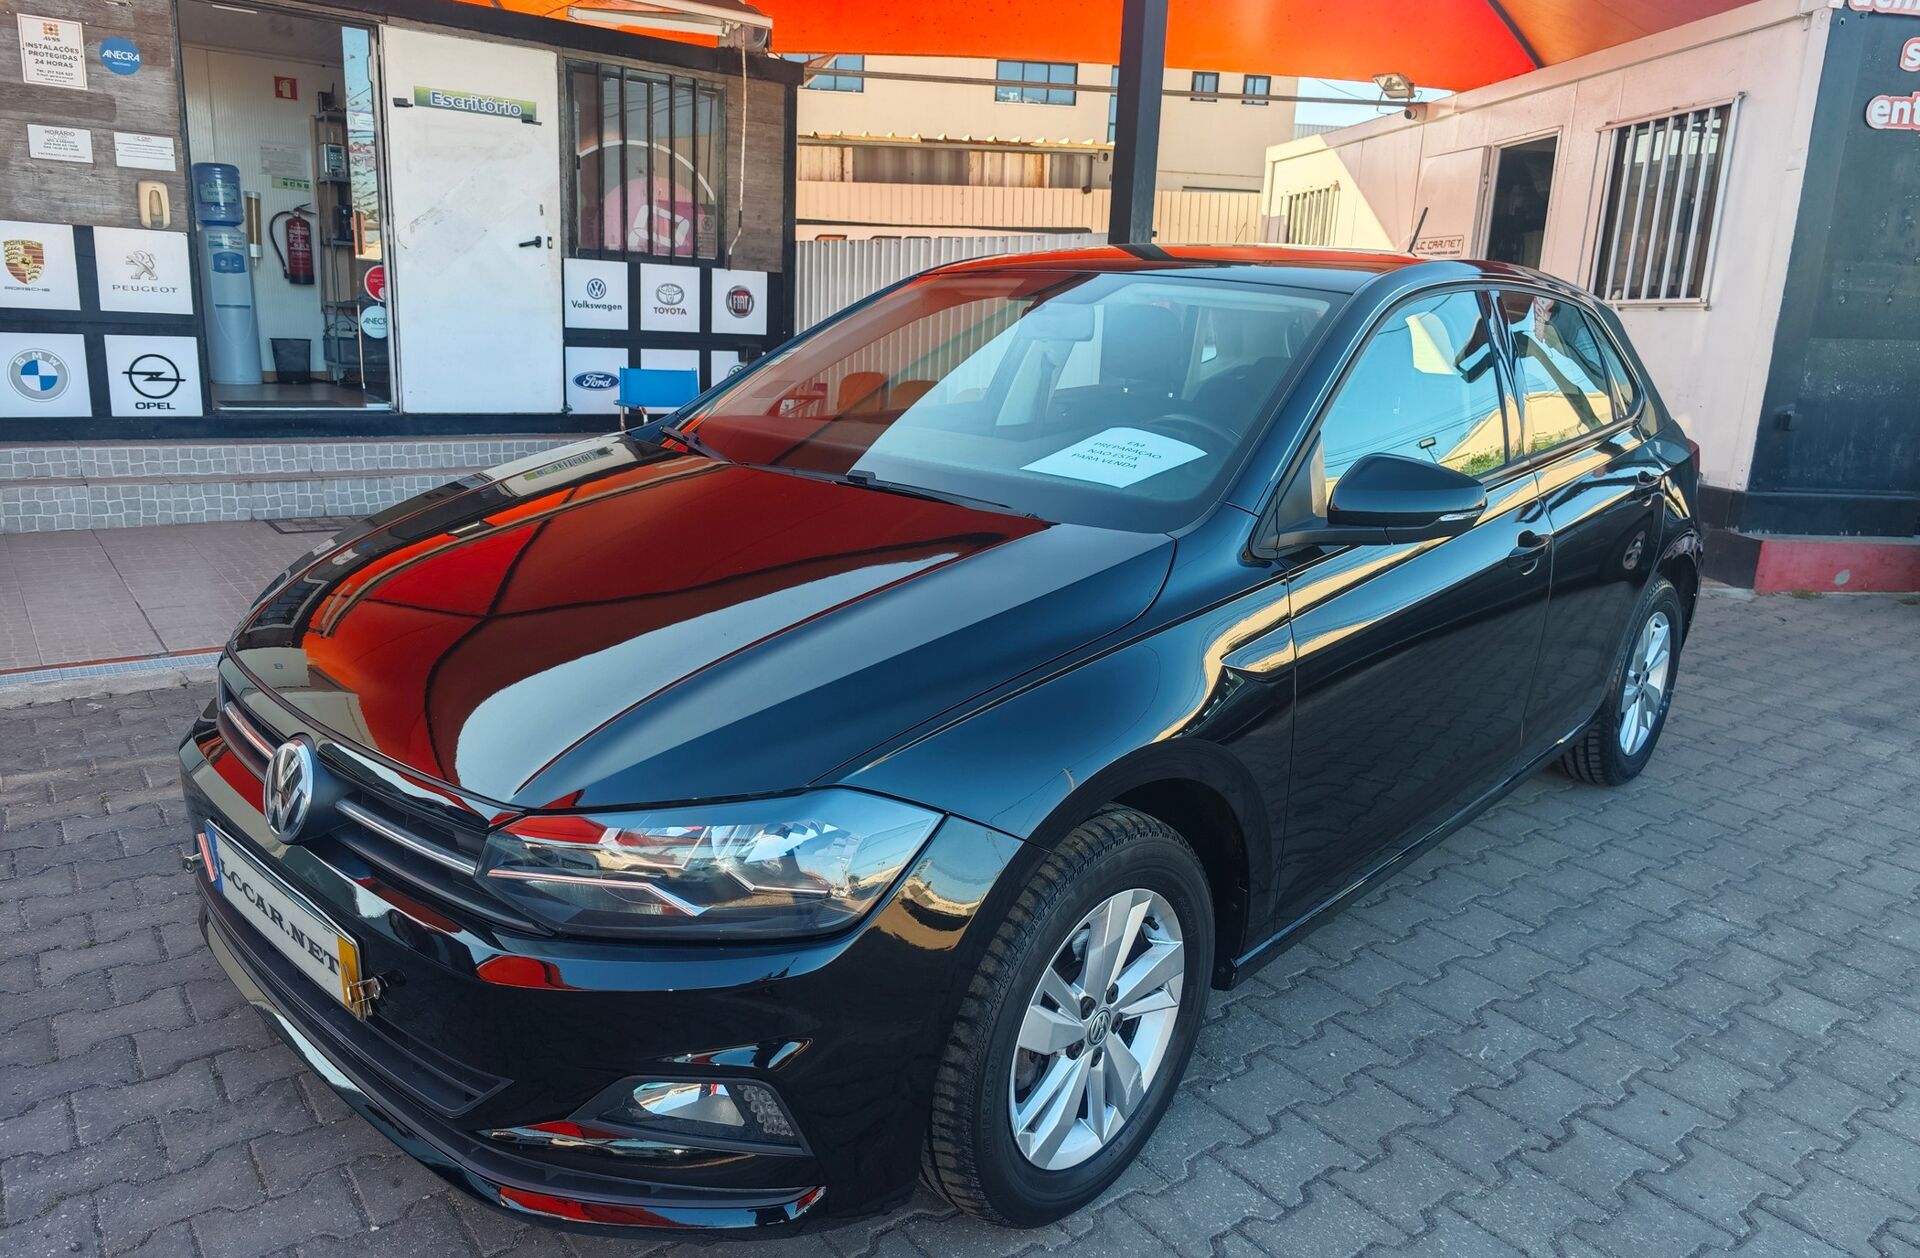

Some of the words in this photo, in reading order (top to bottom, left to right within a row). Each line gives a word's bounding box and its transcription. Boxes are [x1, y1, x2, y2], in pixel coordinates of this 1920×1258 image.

[28, 50, 78, 61] PROTEGIDAS
[102, 49, 140, 62] ANECRA
[46, 60, 74, 68] HORAS
[431, 91, 522, 116] Escritório
[112, 284, 178, 293] PEUGEOT
[571, 300, 622, 312] Volkswagen
[733, 294, 749, 310] FIAT
[653, 306, 687, 316] TOYOTA
[15, 351, 61, 367] BMW
[582, 373, 612, 388] Ford
[135, 402, 176, 410] OPEL
[1071, 453, 1099, 462] PARA
[1102, 458, 1137, 469] VENDA
[219, 858, 339, 976] LCCAR.NET
